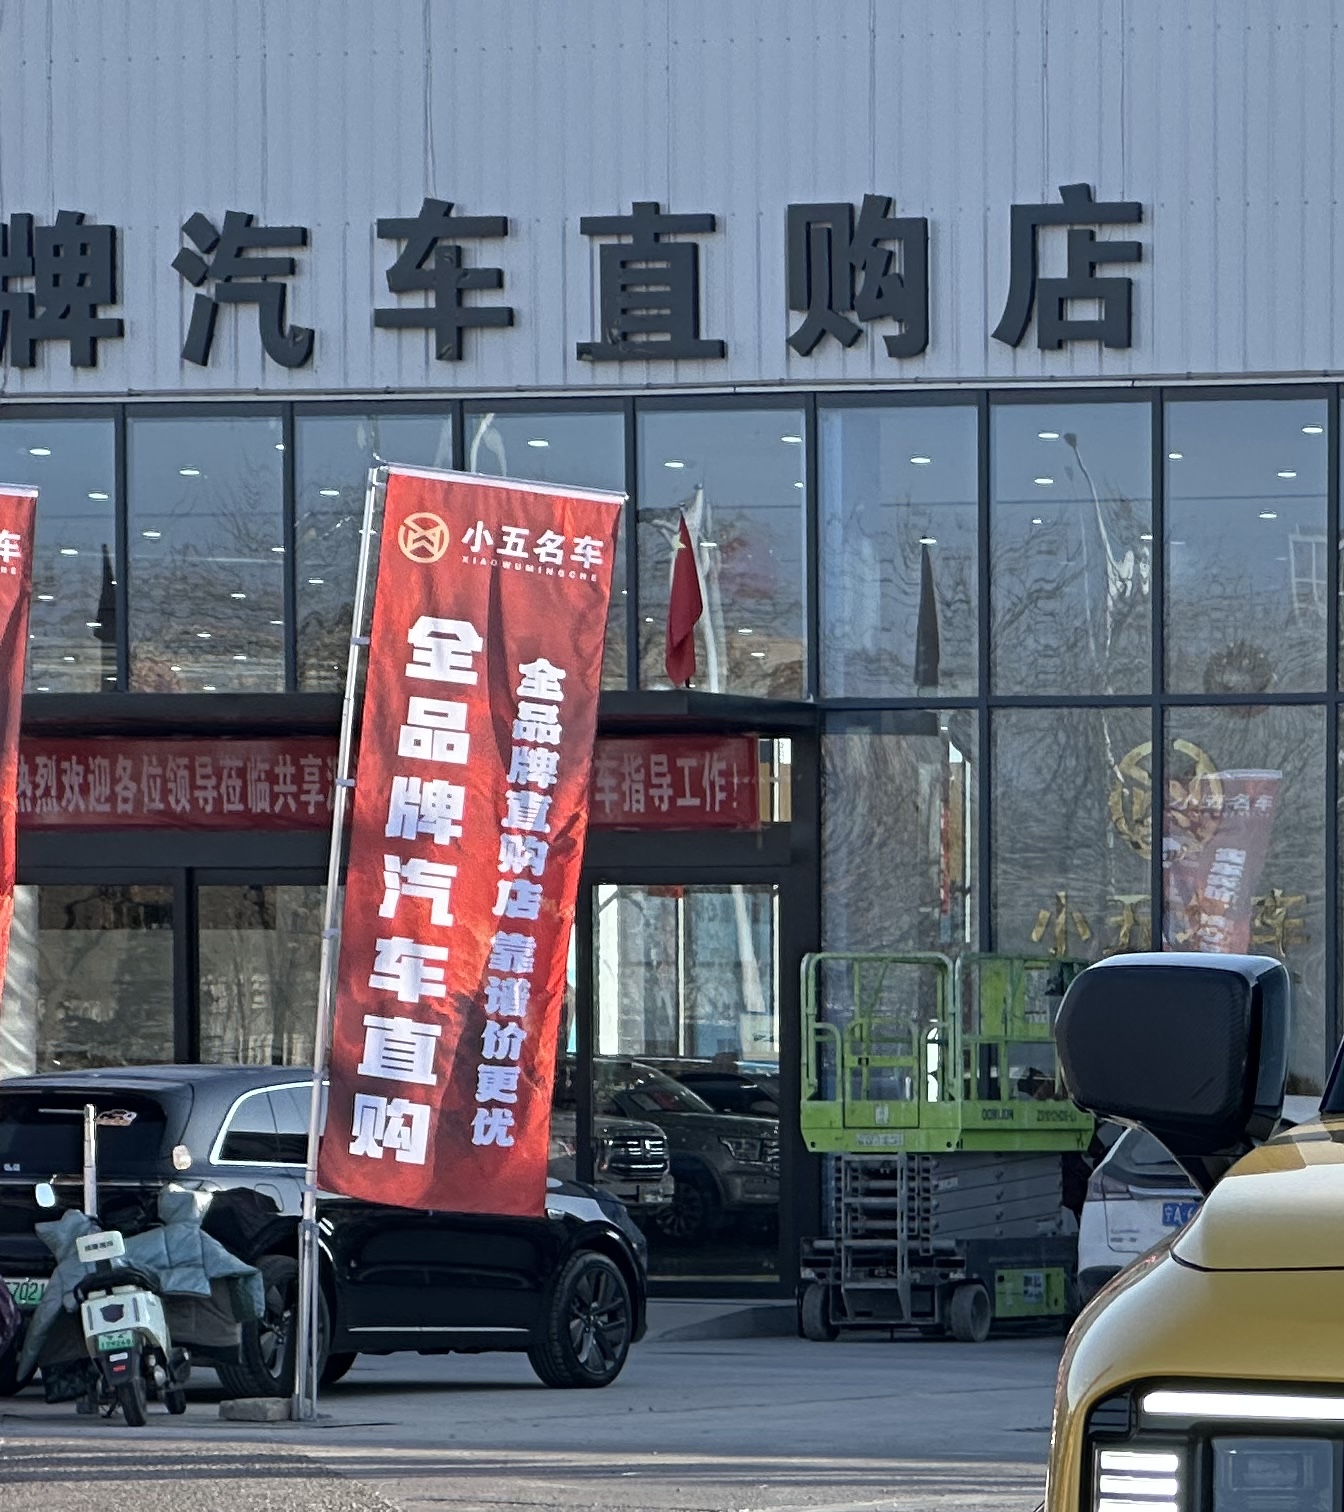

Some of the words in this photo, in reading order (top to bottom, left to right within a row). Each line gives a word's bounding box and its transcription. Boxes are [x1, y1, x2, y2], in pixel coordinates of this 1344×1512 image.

[0, 183, 1143, 368] 牌汽车直购店
[461, 520, 604, 568] 小五名车
[462, 556, 597, 581] XIAOWUMINGCHE
[17, 753, 354, 814] 热烈欢迎各位领导莅临共享
[349, 615, 484, 1165] 全品牌汽车直购
